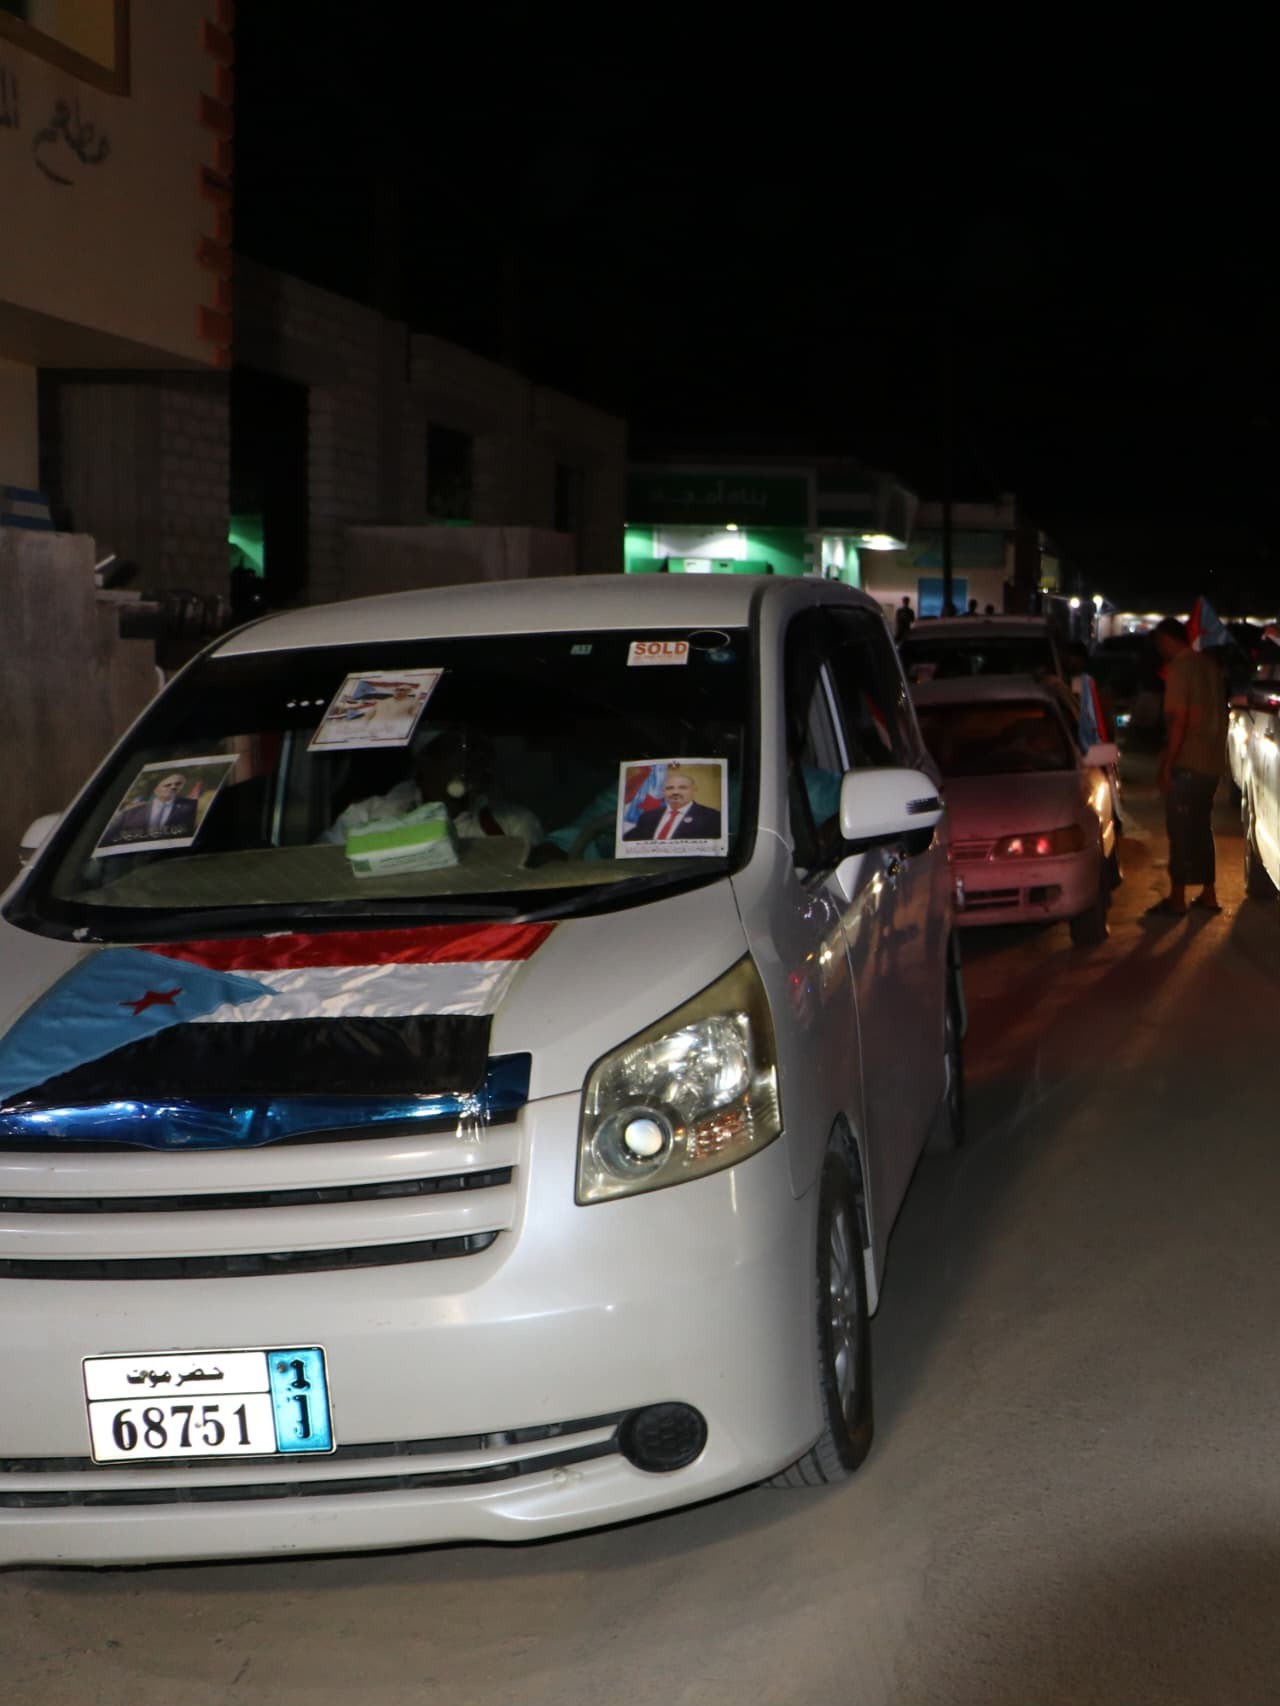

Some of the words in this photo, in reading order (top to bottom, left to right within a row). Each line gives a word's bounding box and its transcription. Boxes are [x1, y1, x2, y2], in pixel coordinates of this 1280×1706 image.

[634, 641, 688, 656] SOLD
[126, 1363, 225, 1389] حضرموت
[112, 1403, 252, 1452] 68751
